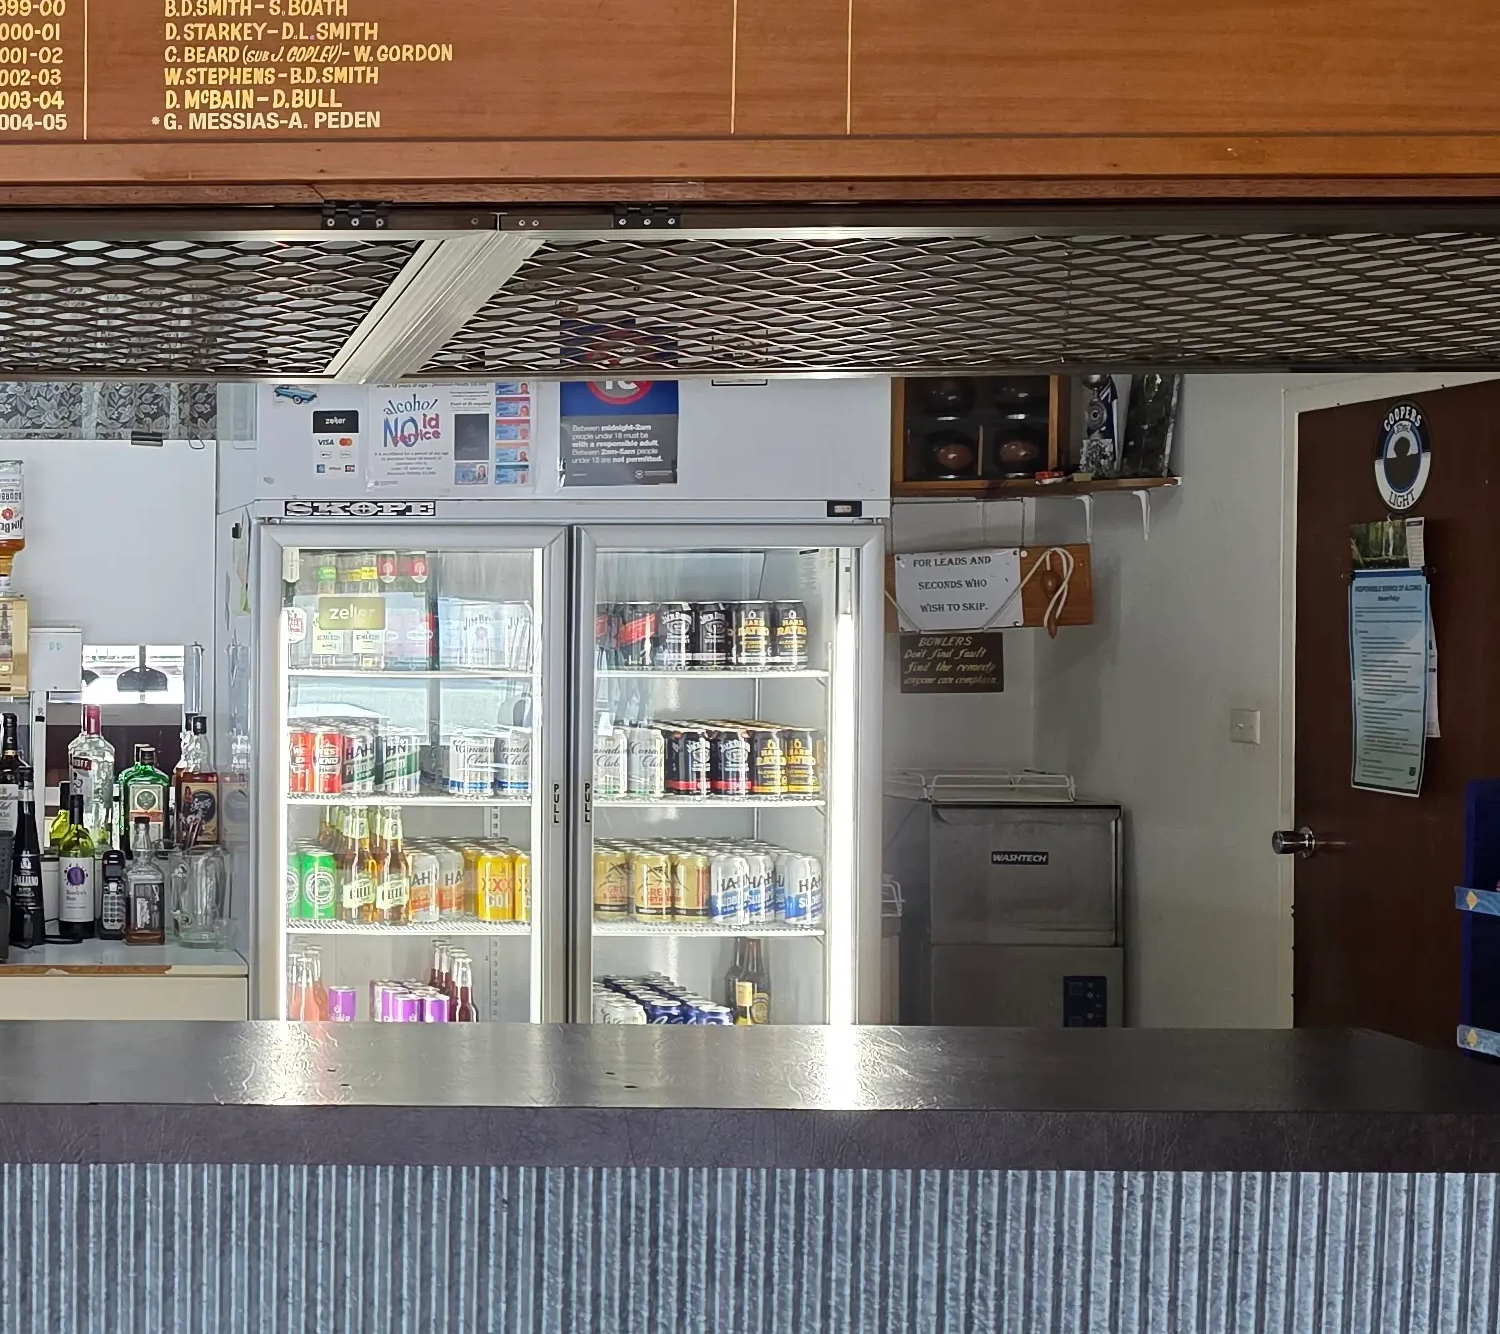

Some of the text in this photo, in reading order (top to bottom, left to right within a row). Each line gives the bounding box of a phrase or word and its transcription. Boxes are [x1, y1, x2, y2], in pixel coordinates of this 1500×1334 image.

[382, 393, 439, 416] alcohol
[422, 413, 440, 429] id
[1383, 406, 1422, 432] COOPERS
[383, 416, 419, 448] NO
[317, 438, 335, 446] VISA
[1388, 488, 1416, 508] LIGHT
[285, 501, 436, 517] SKOPE
[10, 516, 24, 530] JIM
[912, 555, 992, 568] FOR LEADS AND
[917, 578, 988, 590] SECONDS WHO
[920, 602, 989, 613] WISH TO SKIP.
[918, 636, 973, 647] BOWLERS
[553, 783, 561, 824] PULL
[583, 782, 591, 824] PULL
[992, 854, 1047, 863] WASHTECH
